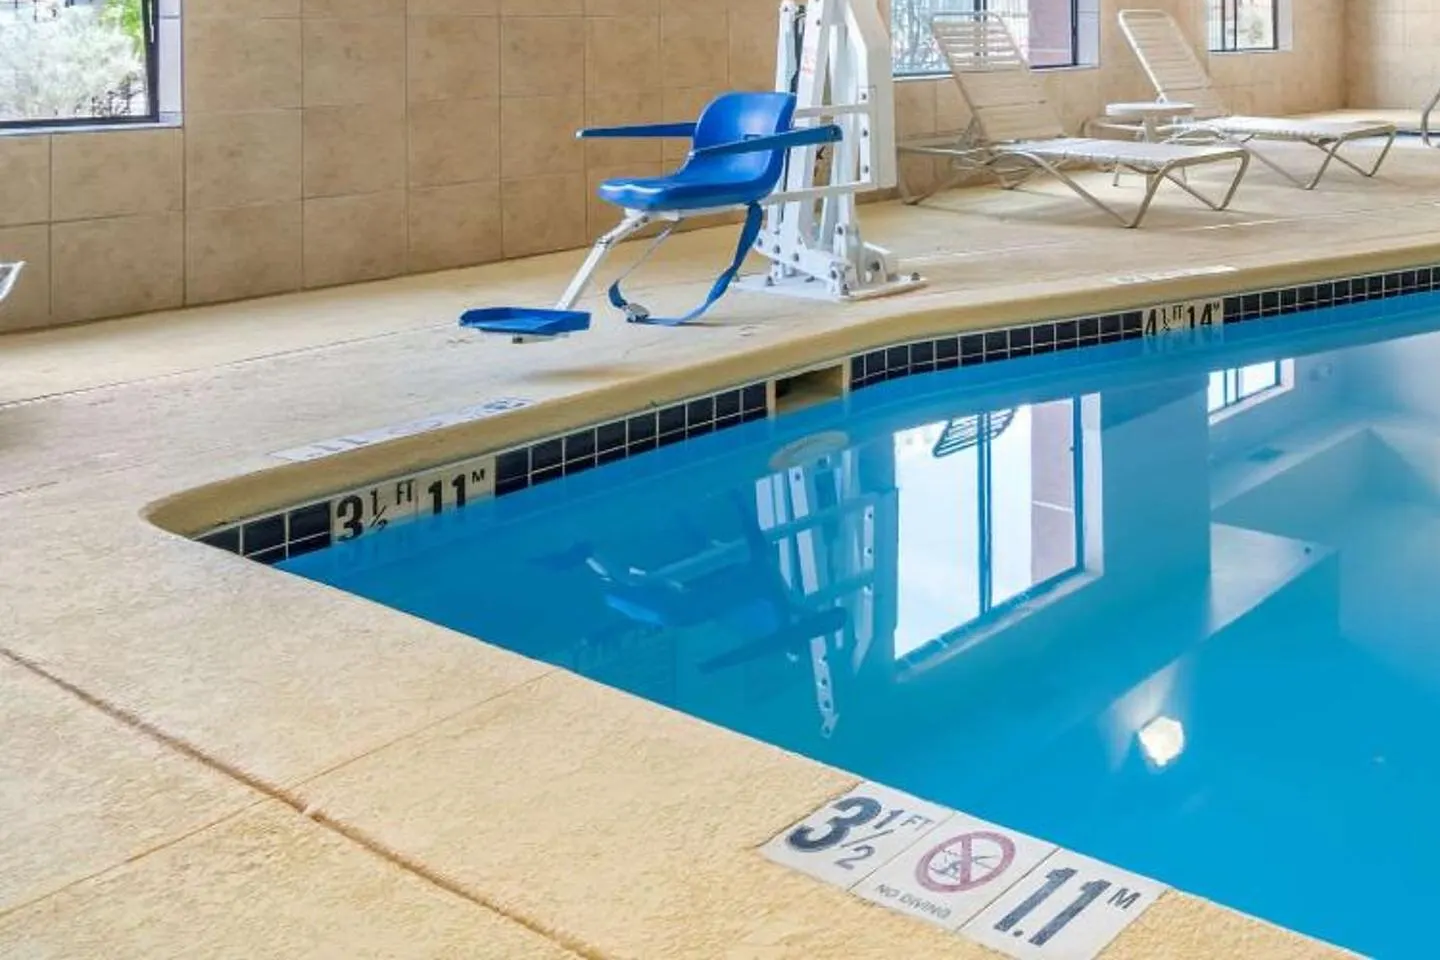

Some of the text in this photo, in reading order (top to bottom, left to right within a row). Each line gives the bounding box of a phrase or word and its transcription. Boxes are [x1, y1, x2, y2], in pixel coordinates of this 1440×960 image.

[472, 468, 485, 483] M
[336, 494, 363, 542] 3
[396, 478, 414, 505] FT
[786, 796, 883, 853] 3
[900, 814, 936, 832] FT
[876, 883, 952, 920] NO DIVING
[993, 866, 1142, 947] 1.1 M
